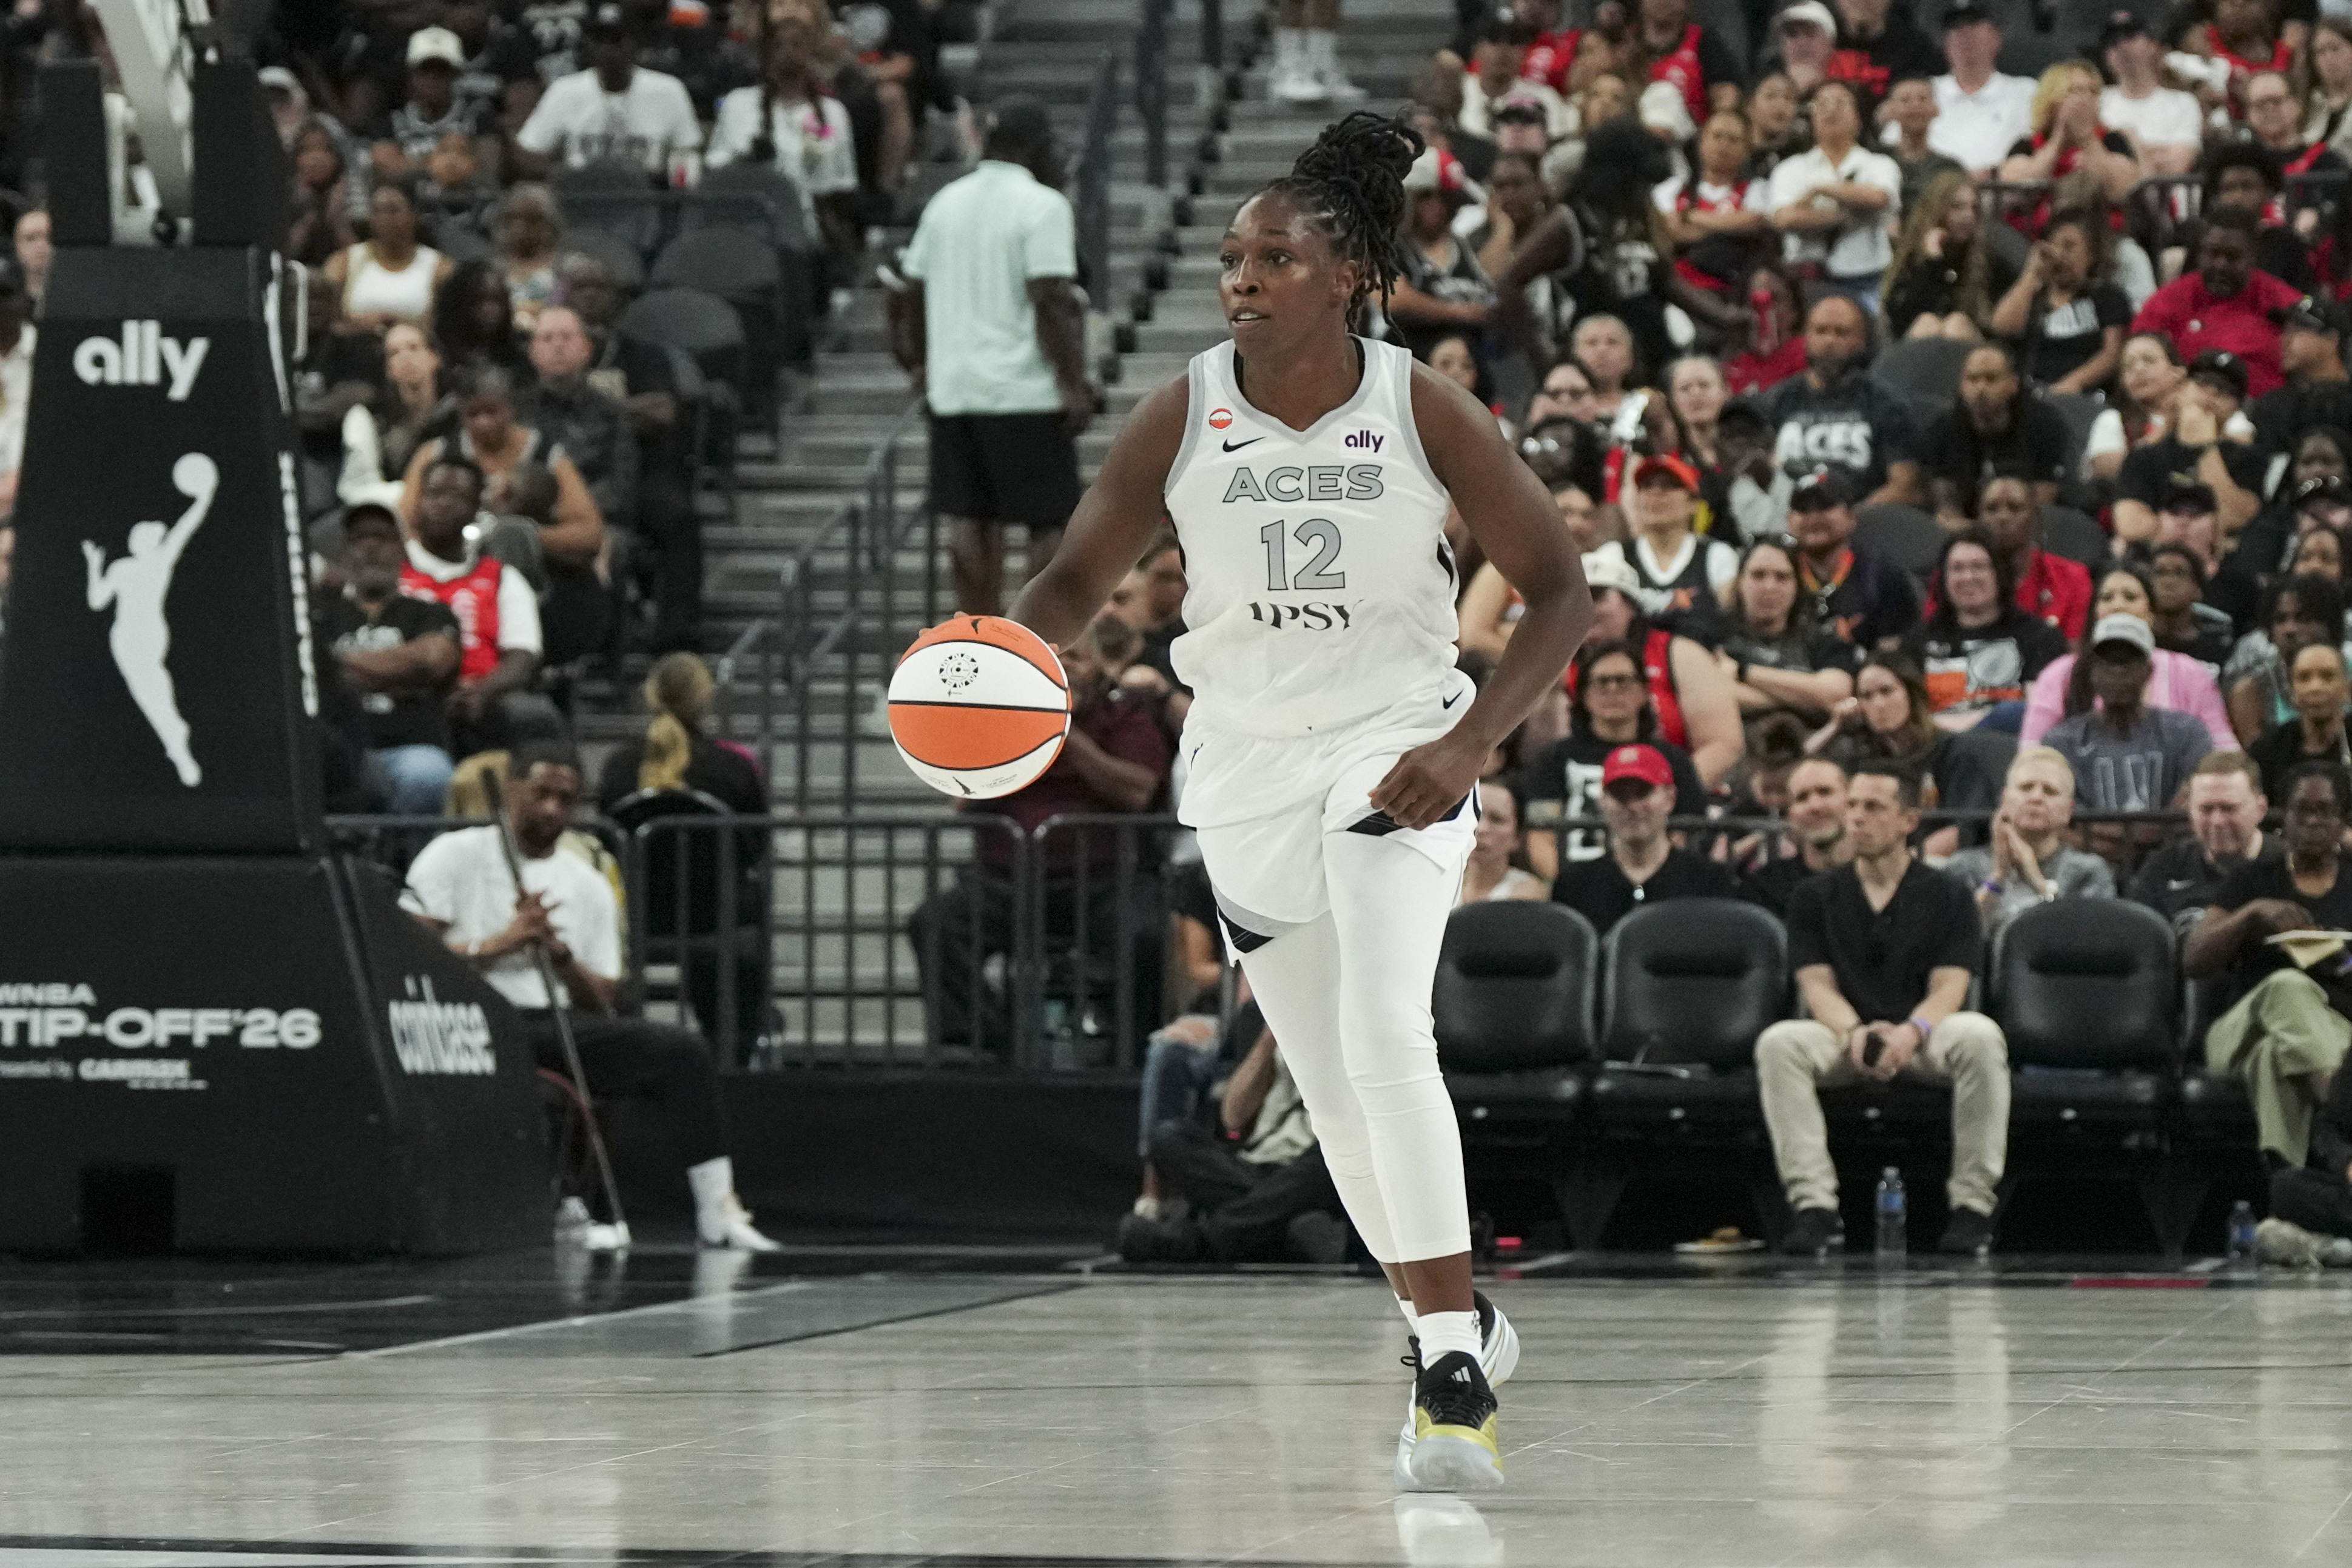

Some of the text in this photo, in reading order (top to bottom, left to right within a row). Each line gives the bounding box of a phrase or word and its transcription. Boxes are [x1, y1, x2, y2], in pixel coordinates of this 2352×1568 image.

[73, 318, 211, 401] ally
[1344, 429, 1384, 453] ally
[1222, 464, 1384, 503] ACES
[1261, 518, 1346, 591] 12
